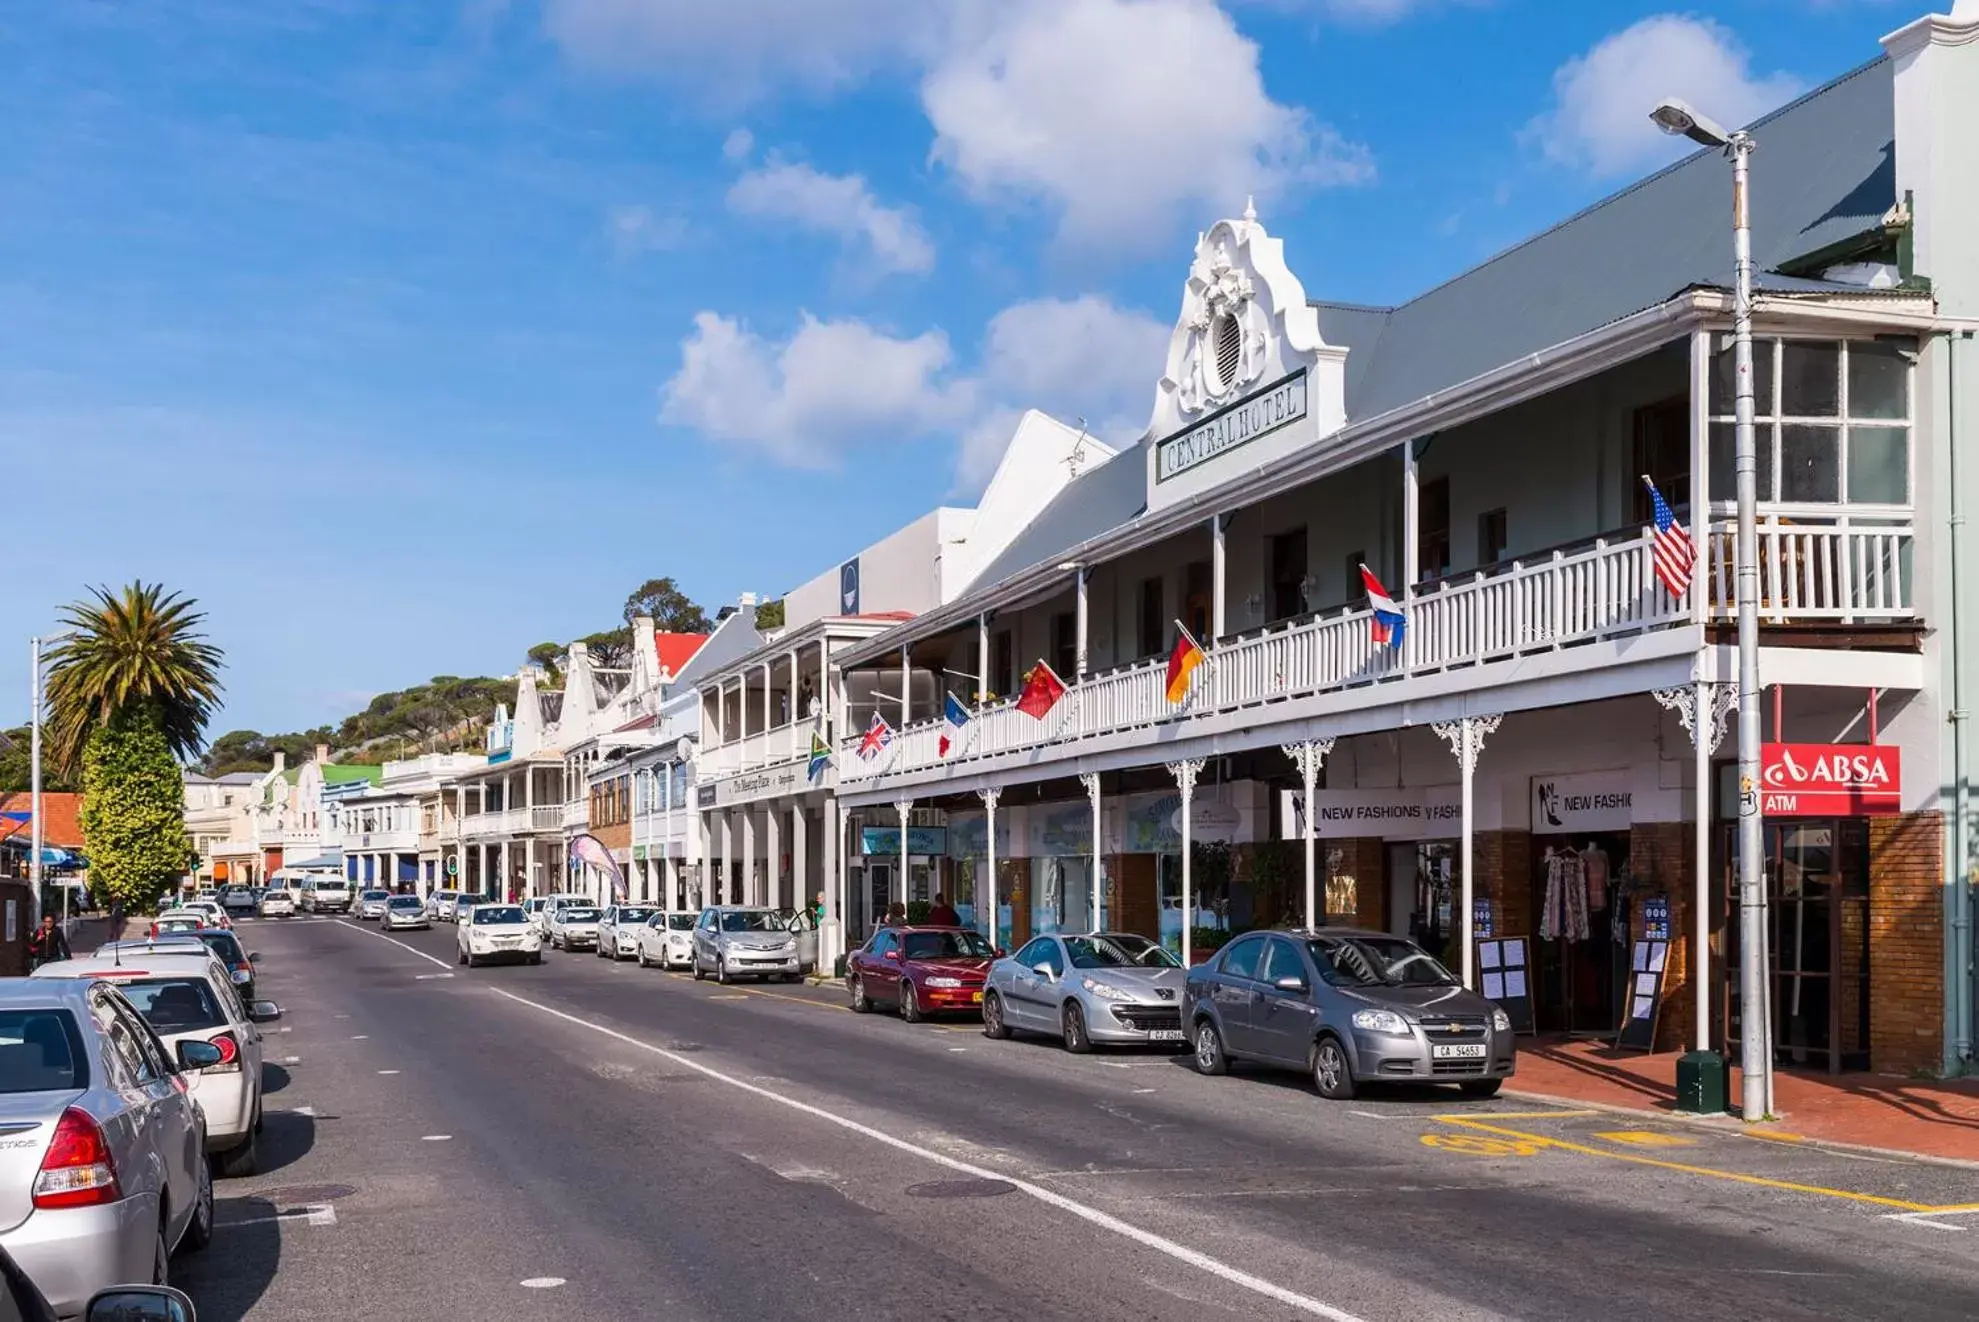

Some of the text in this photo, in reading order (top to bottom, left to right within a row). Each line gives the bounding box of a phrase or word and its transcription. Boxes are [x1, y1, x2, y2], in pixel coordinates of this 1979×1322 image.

[1168, 386, 1297, 472] CENTRAL HOTEL
[1810, 755, 1890, 783] ABSA
[1564, 796, 1592, 811] NEW
[1765, 795, 1797, 812] ATM
[1321, 805, 1421, 820] NEW FASHIONS
